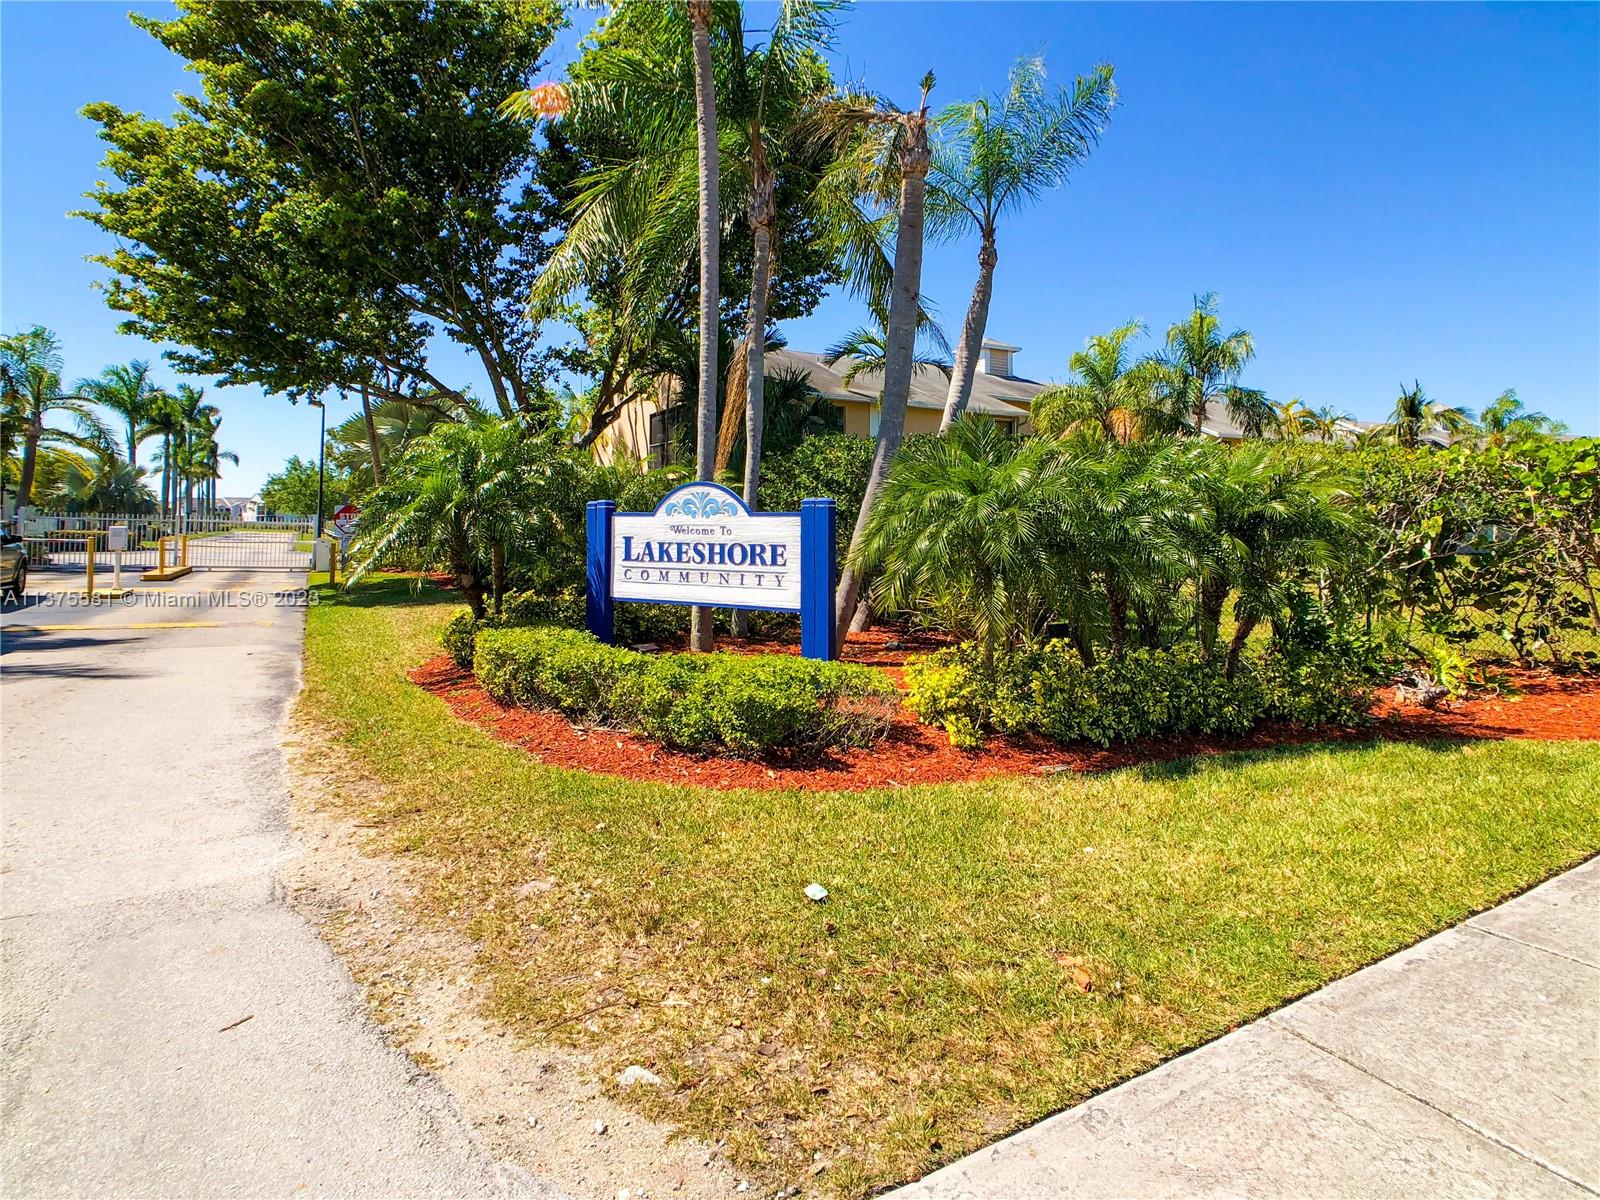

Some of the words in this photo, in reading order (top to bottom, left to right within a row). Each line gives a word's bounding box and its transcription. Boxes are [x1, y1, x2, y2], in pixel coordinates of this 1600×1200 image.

[670, 525, 715, 536] Welcome
[719, 525, 732, 536] To
[622, 536, 787, 567] LAKESHORE
[623, 568, 785, 587] COMMUNITY
